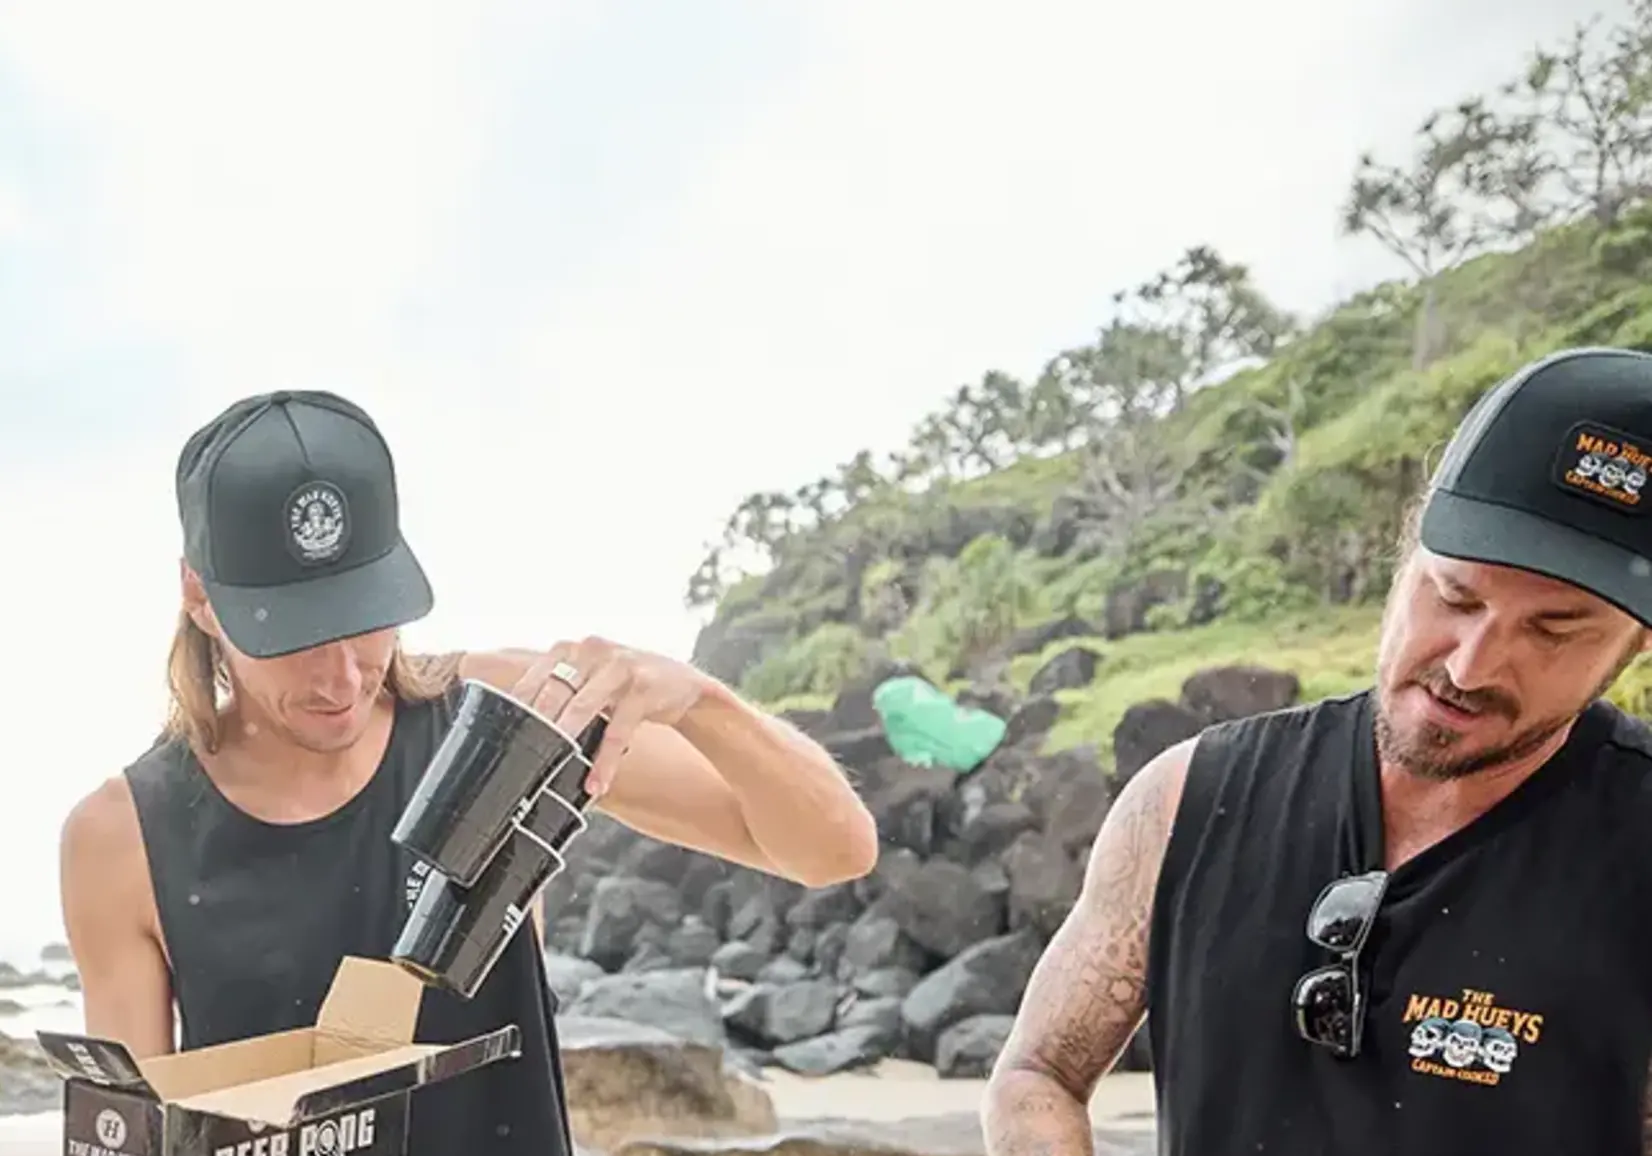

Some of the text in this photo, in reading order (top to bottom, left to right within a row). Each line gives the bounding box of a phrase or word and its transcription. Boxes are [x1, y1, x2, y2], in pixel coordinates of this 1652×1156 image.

[1461, 988, 1495, 1006] THE
[1402, 993, 1545, 1044] MAD HUEYS
